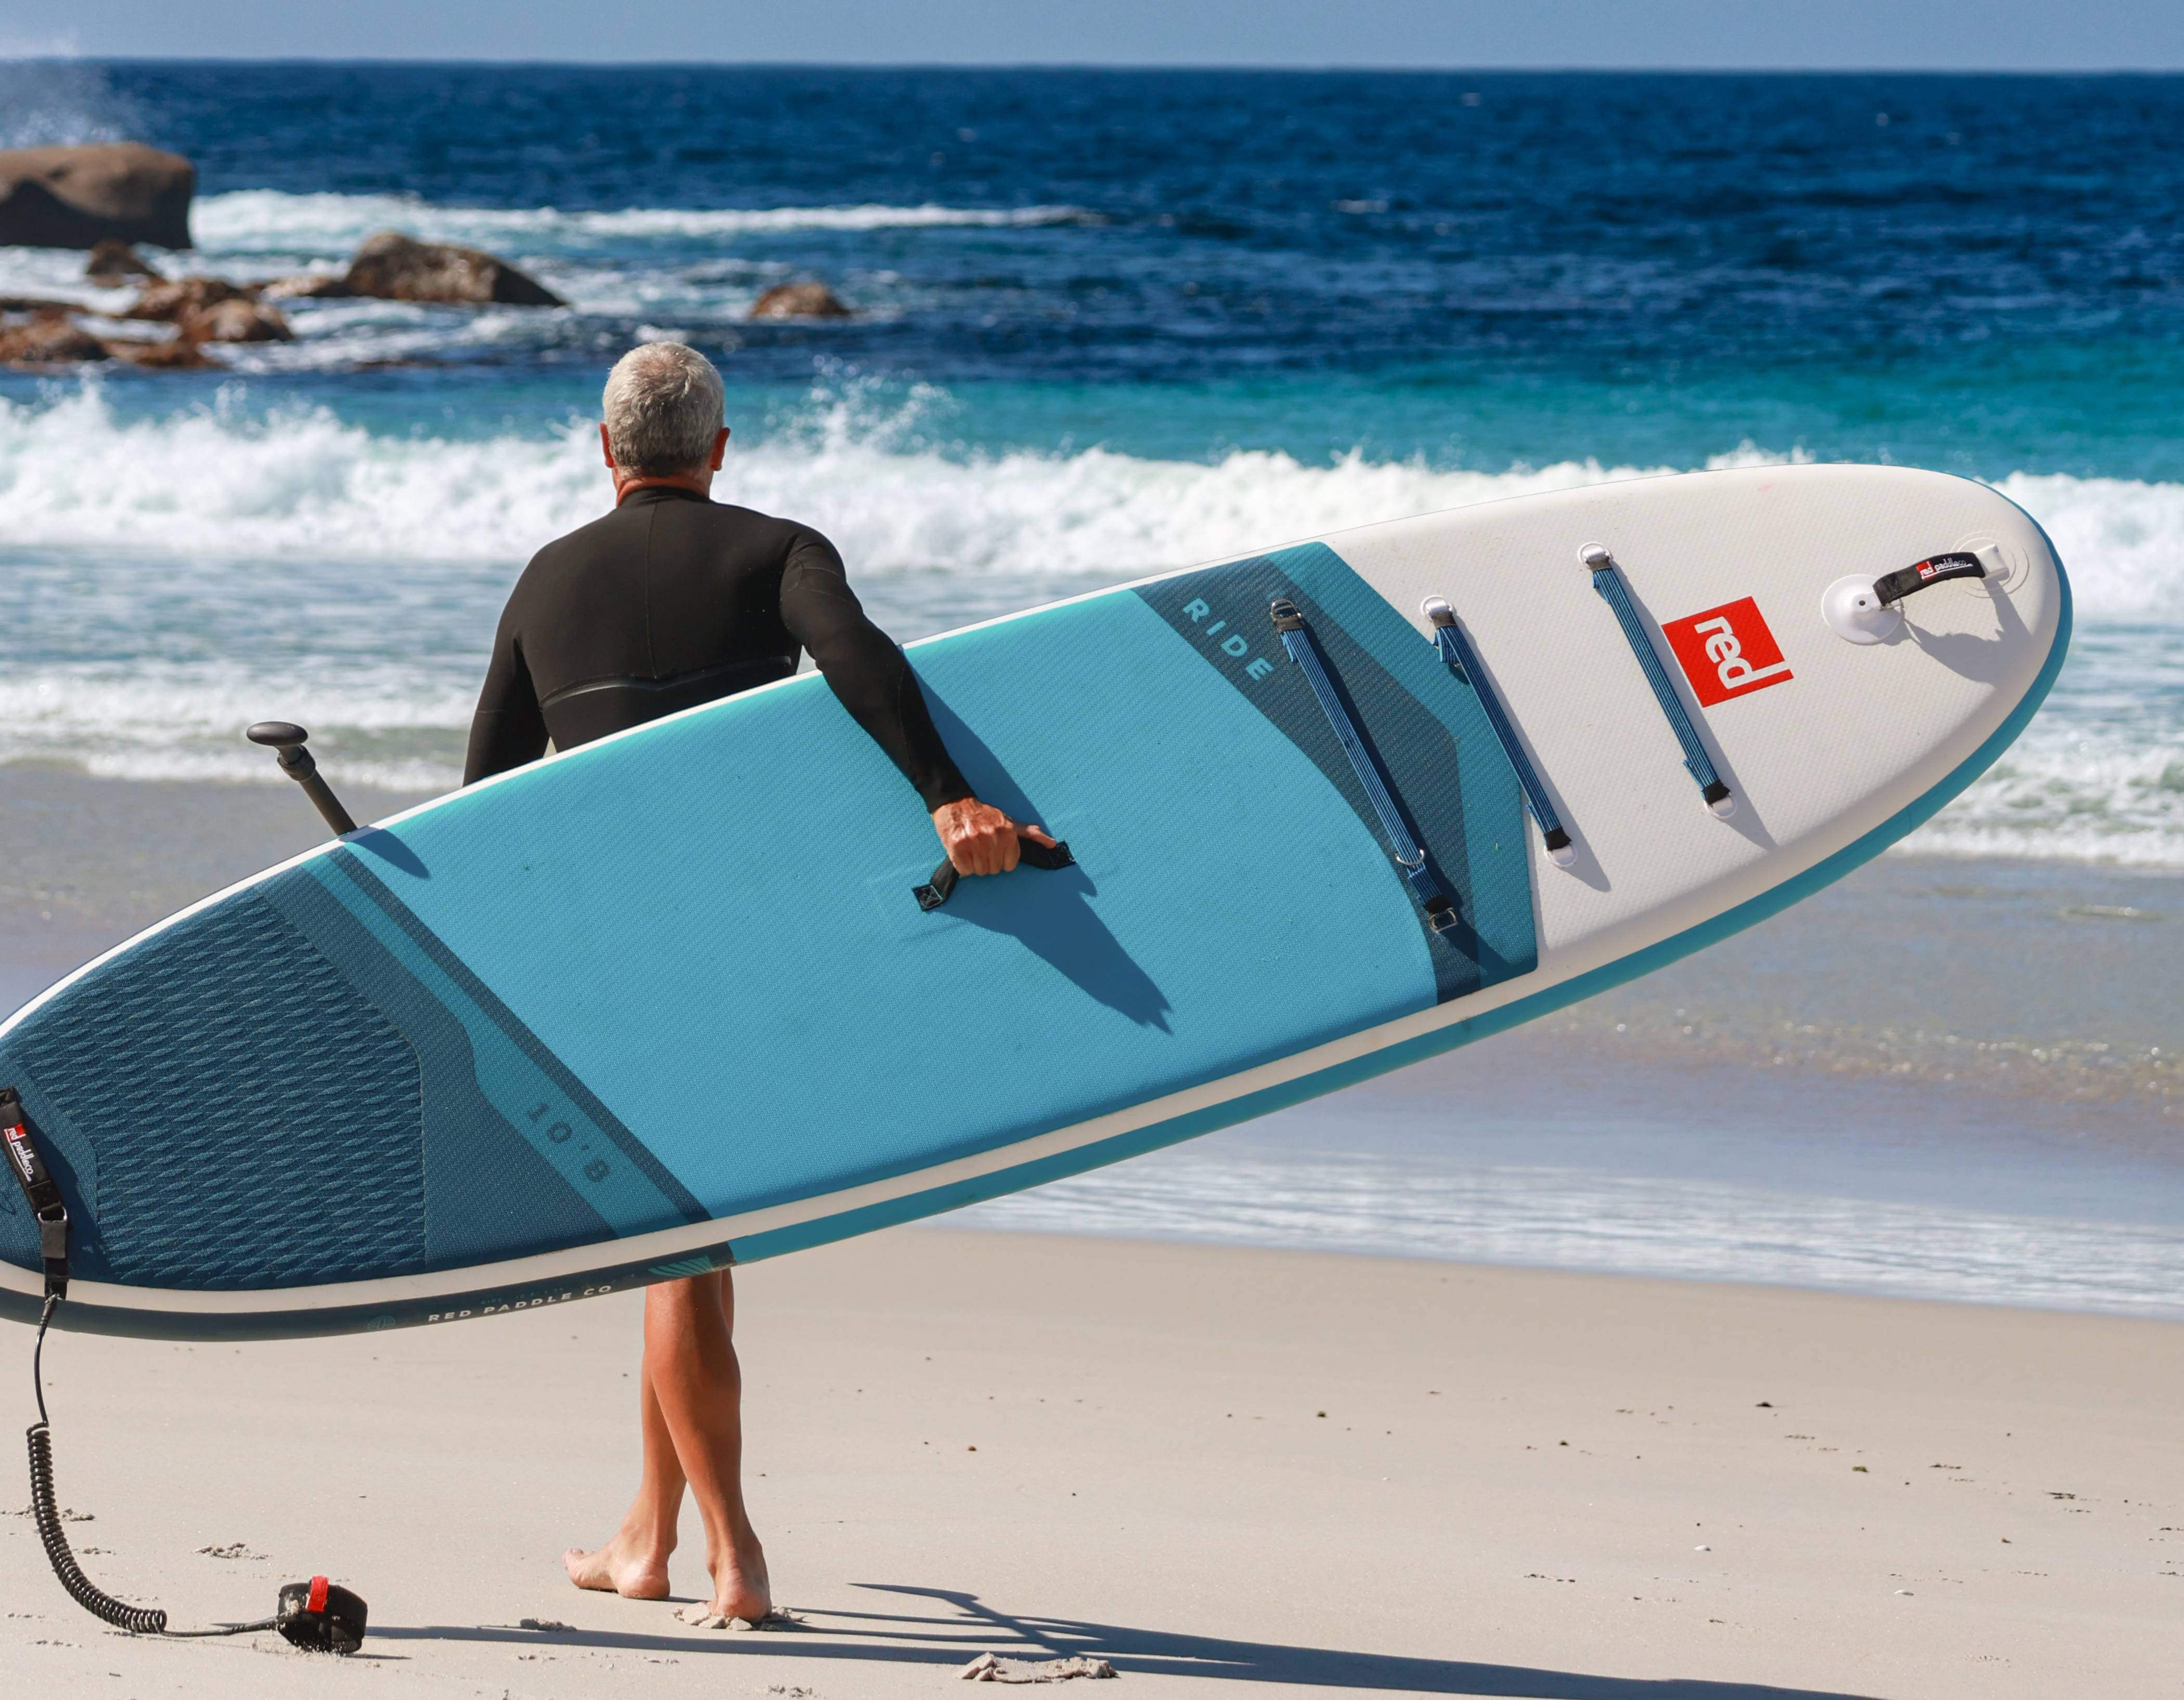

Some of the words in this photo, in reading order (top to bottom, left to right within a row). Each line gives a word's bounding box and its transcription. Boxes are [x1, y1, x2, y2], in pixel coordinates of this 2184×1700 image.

[1920, 561, 1934, 576] red
[1182, 598, 1273, 681] RIDE
[1694, 616, 1790, 690] red
[7, 1127, 27, 1140] red
[428, 1310, 472, 1322] RED
[484, 1292, 572, 1314] PADDLE
[583, 1285, 612, 1296] CO
